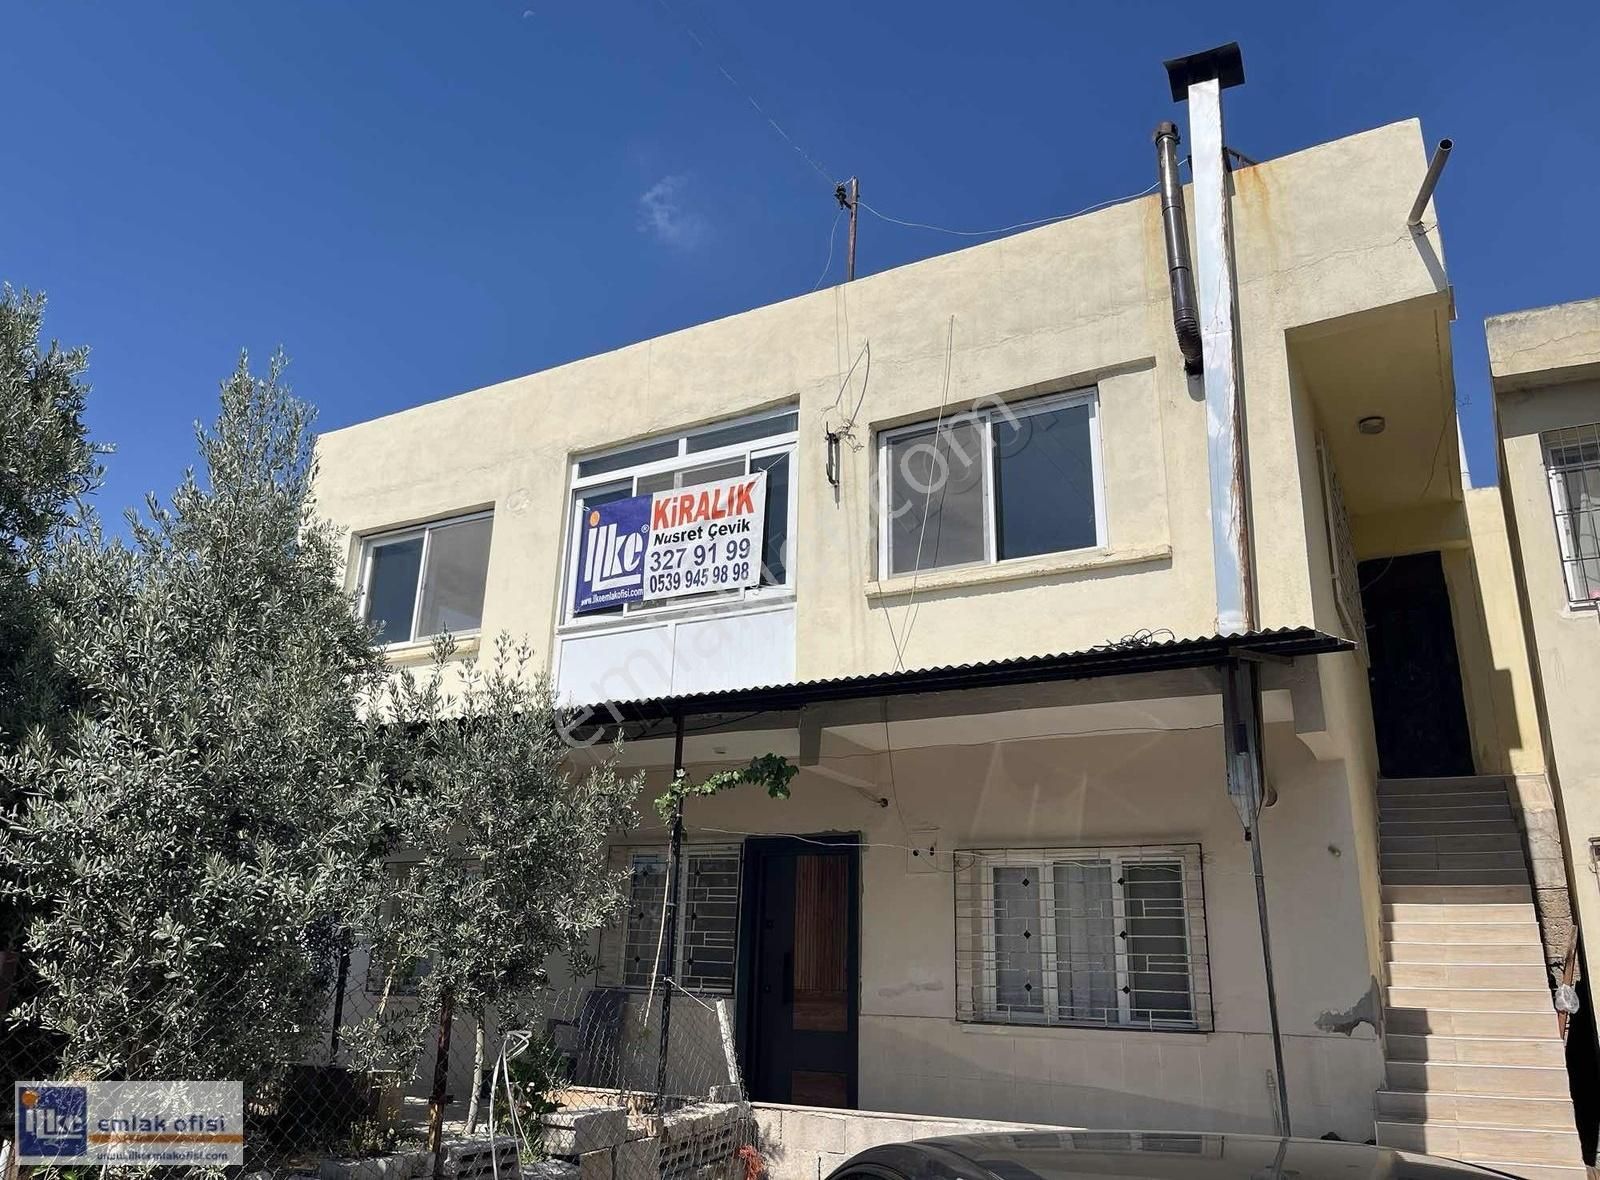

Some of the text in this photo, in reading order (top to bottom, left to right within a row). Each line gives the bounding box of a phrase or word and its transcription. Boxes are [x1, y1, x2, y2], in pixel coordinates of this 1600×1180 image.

[653, 519, 750, 546] Nusret Çevik
[650, 538, 750, 572] 327 91 99
[649, 561, 749, 594] 0539 945 98 98
